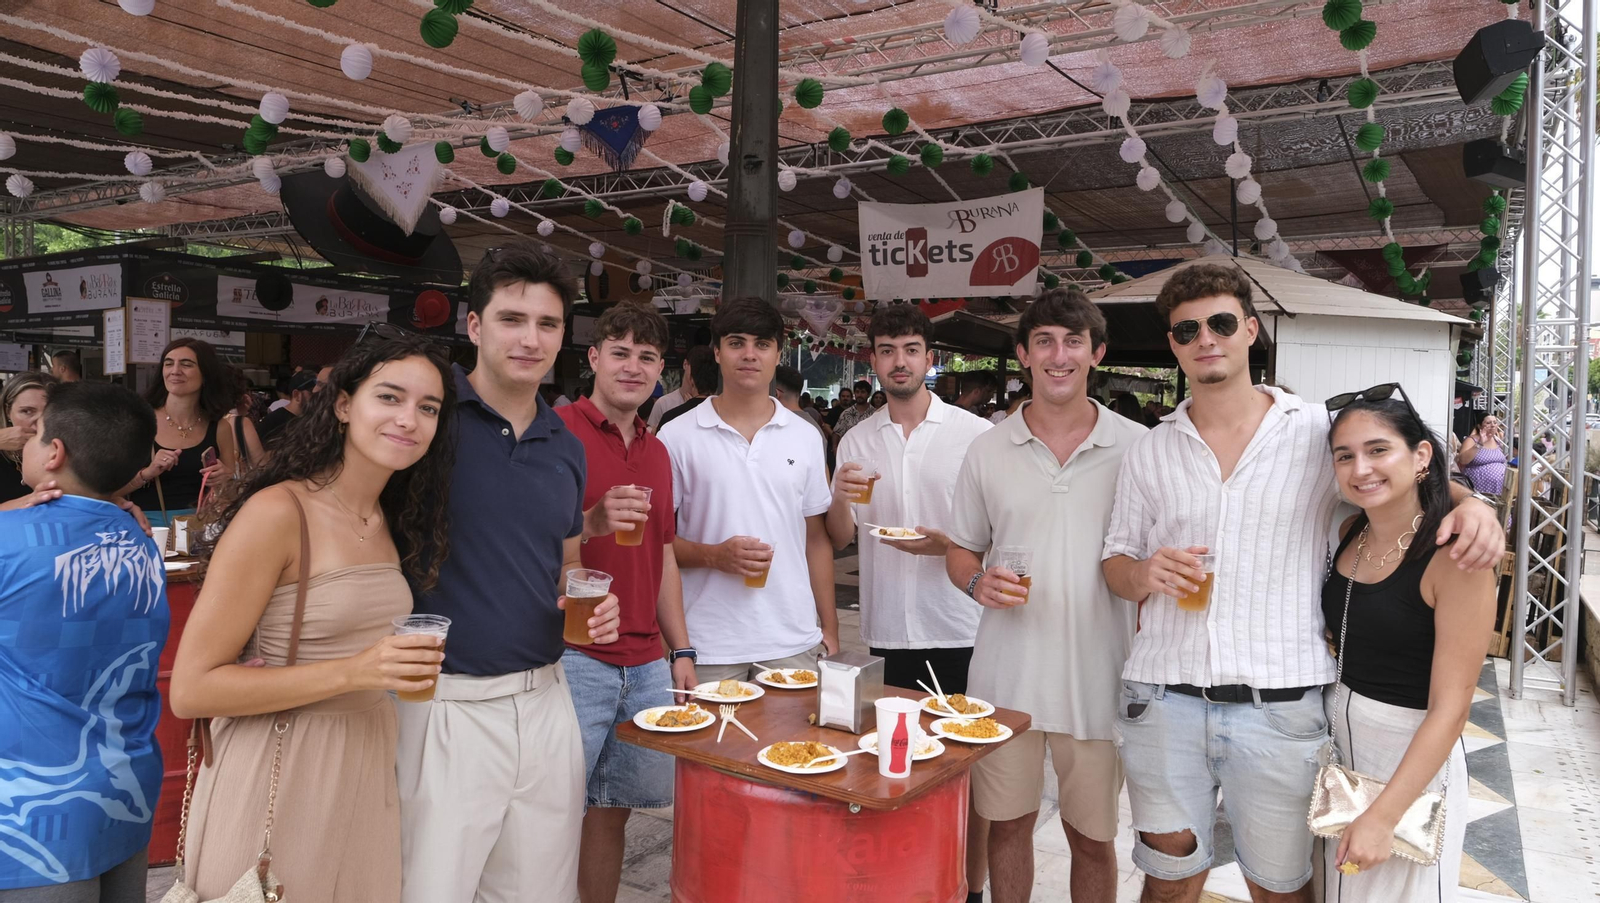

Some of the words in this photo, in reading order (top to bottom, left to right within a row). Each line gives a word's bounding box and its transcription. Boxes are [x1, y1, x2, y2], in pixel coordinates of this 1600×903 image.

[867, 231, 893, 242] venta
[893, 230, 905, 241] de
[151, 281, 181, 293] Estrella
[152, 289, 180, 301] Galicia
[95, 530, 136, 545] EL
